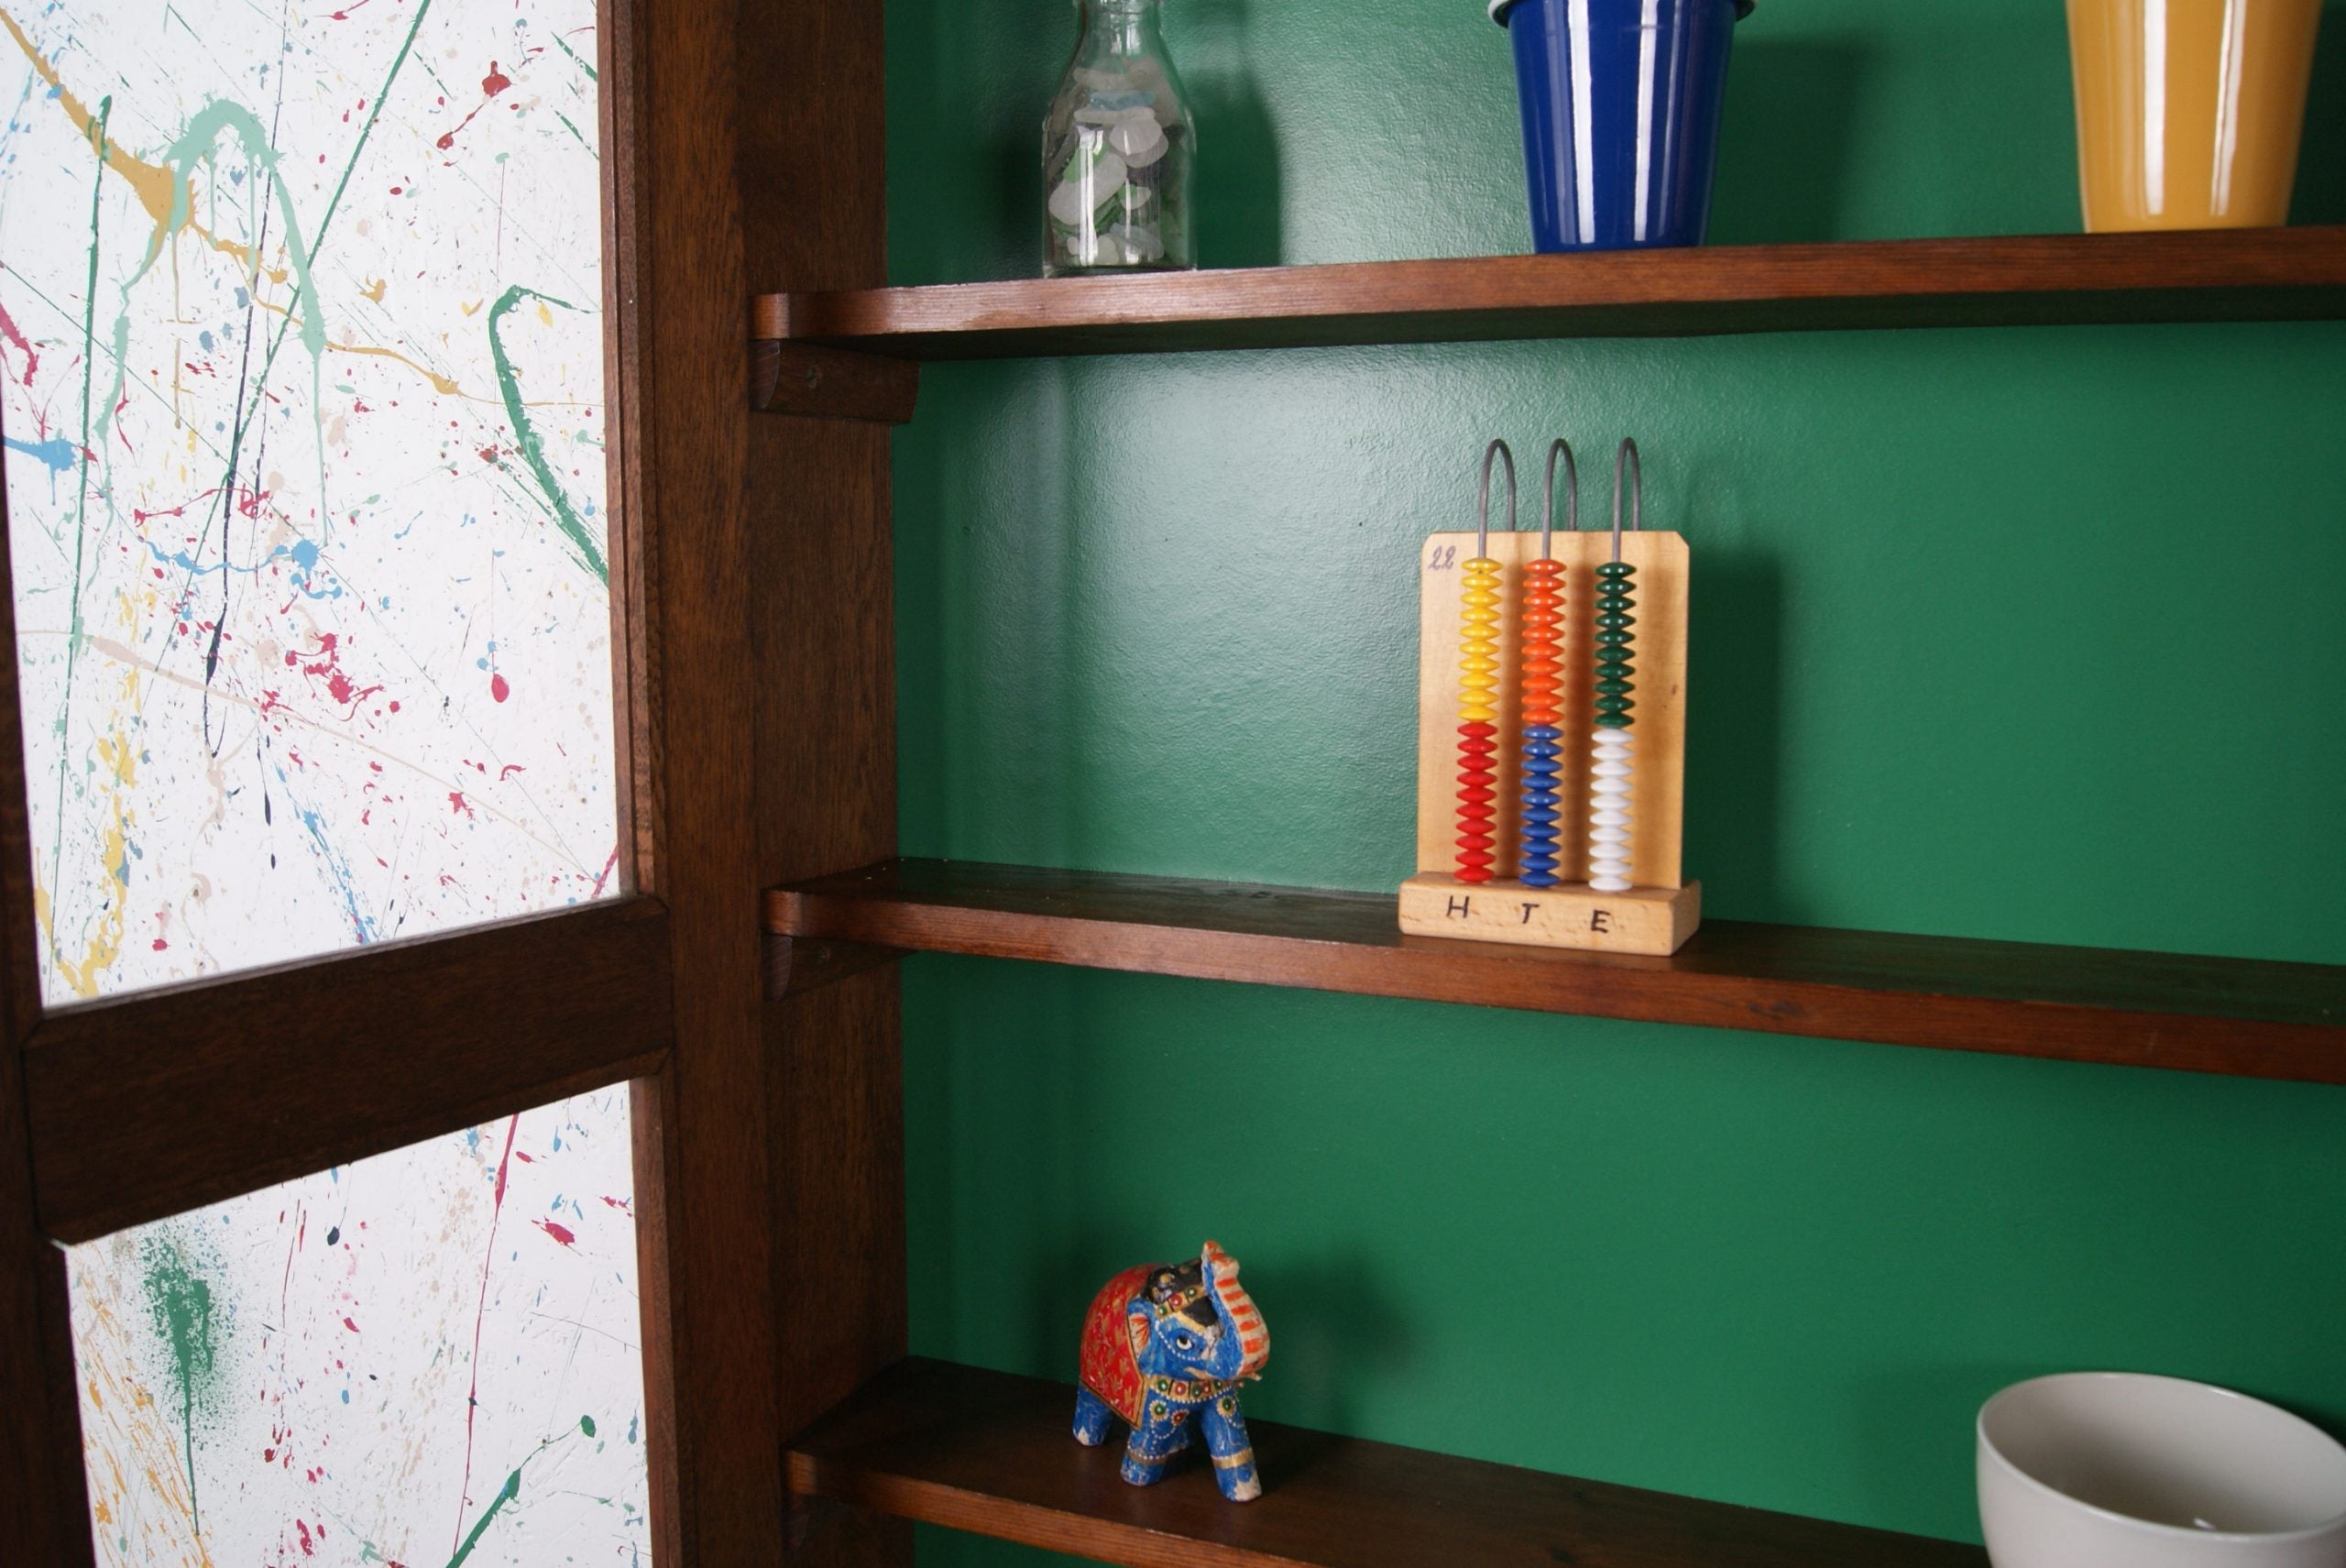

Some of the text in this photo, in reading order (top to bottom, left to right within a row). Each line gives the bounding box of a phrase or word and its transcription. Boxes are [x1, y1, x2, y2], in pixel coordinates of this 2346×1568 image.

[1446, 895, 1611, 933] H T E
